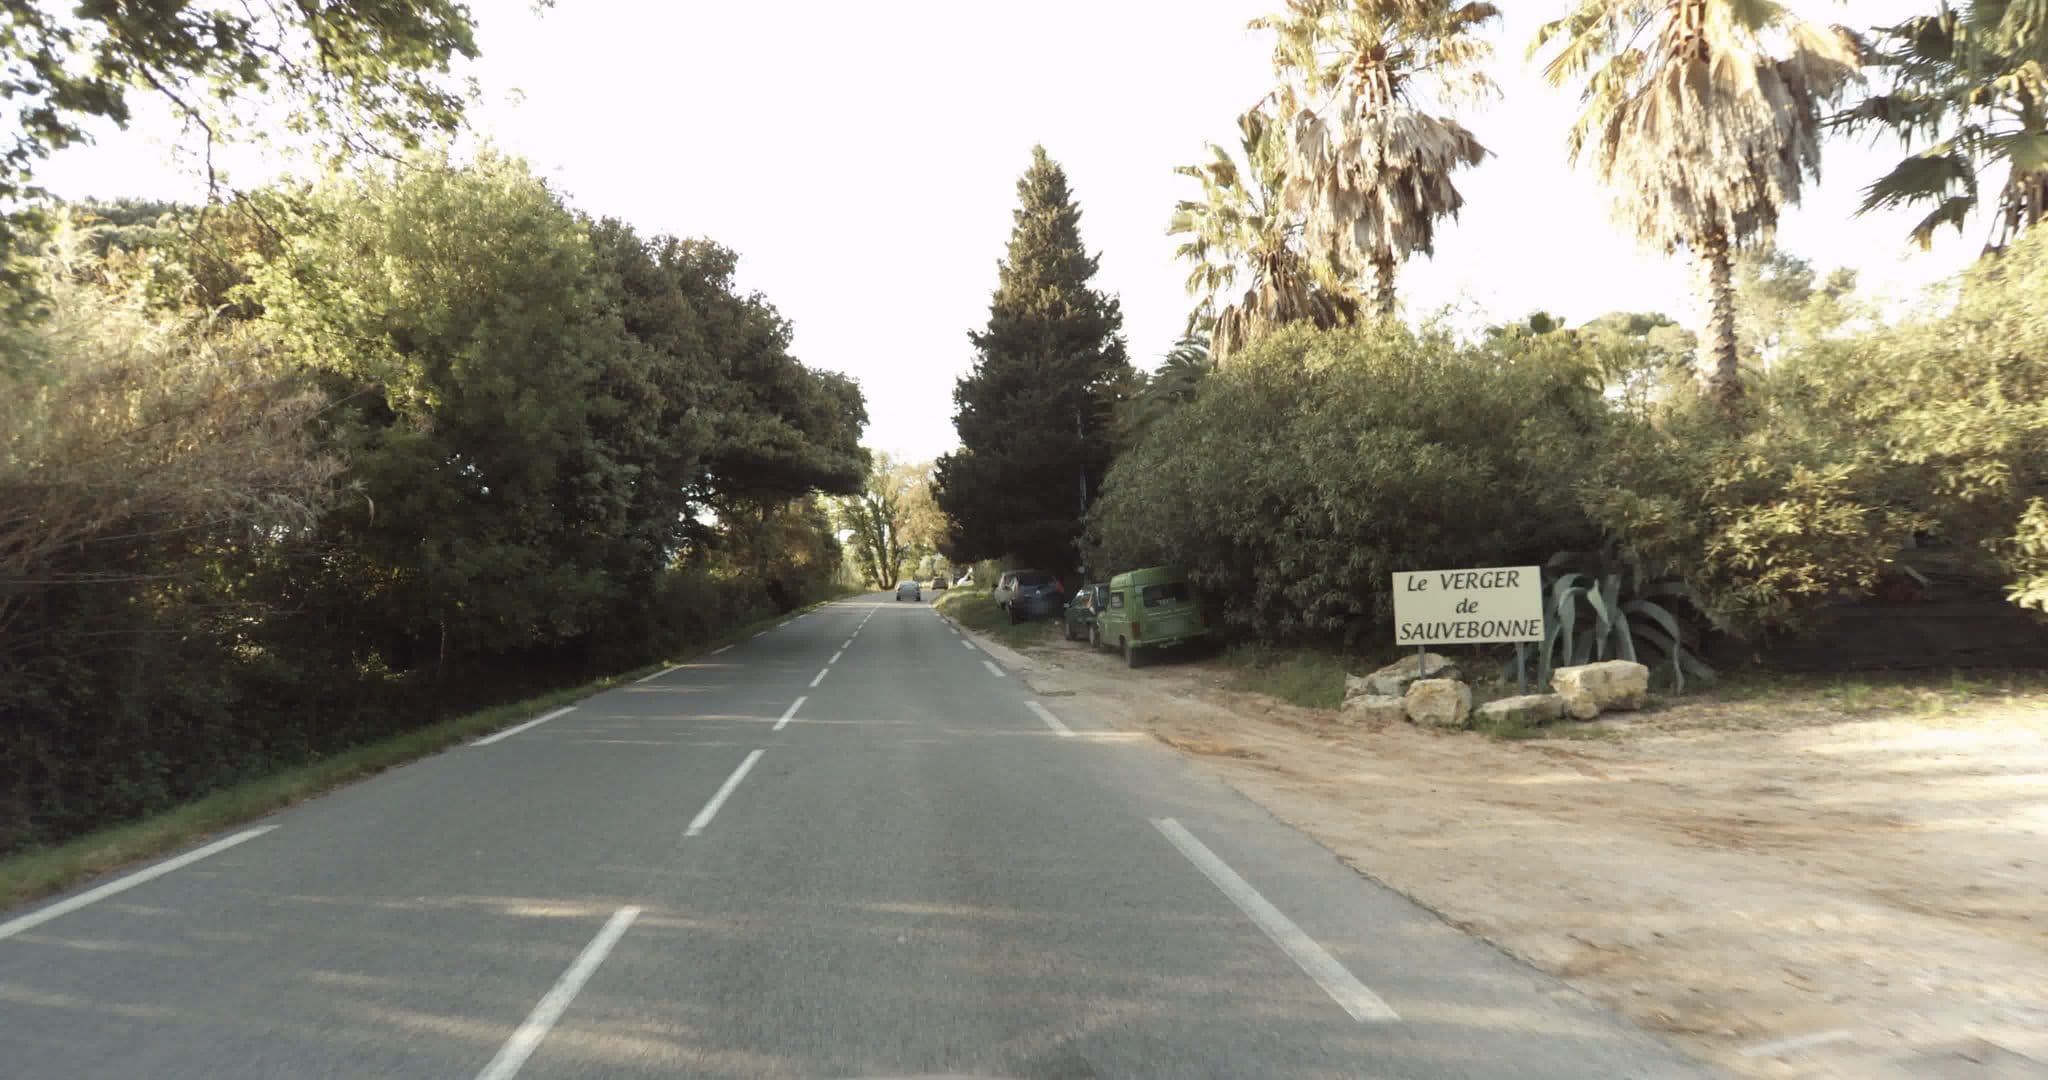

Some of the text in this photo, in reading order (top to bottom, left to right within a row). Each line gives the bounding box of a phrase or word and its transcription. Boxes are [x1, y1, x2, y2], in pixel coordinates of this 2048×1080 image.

[1407, 570, 1520, 592] Le VERGER
[1455, 598, 1479, 614] de
[1399, 619, 1541, 640] SAUVEBONNE
